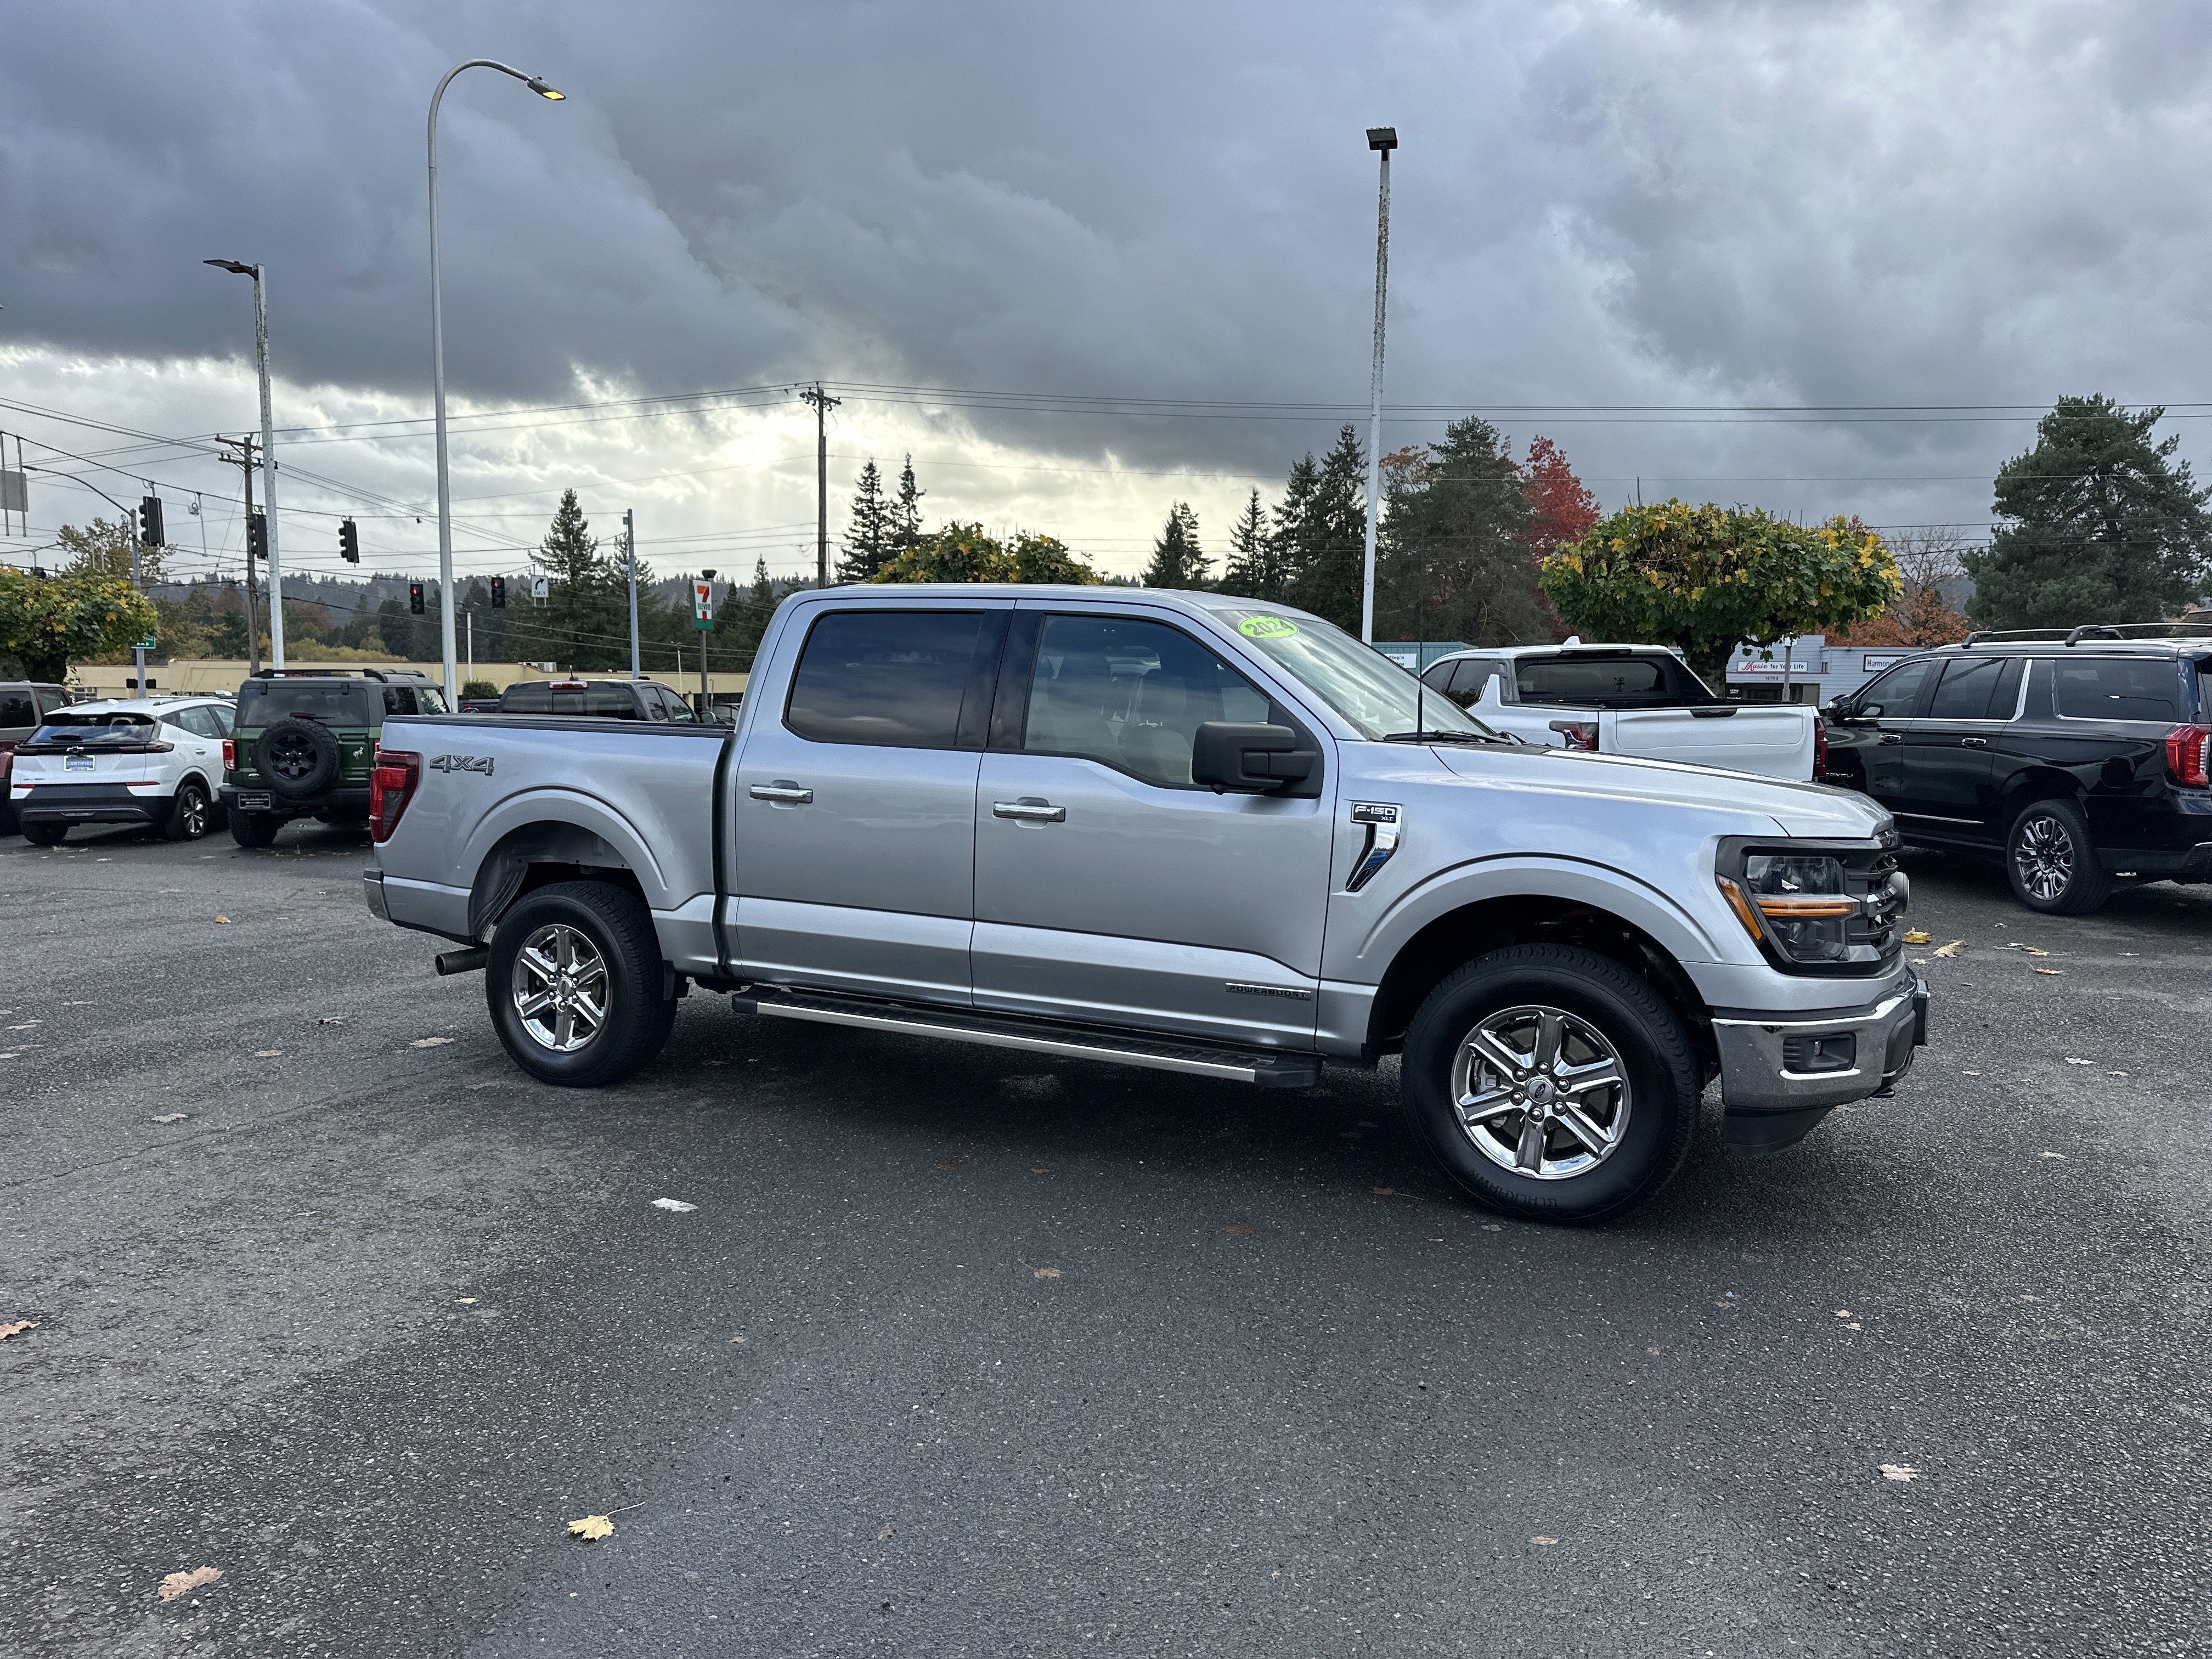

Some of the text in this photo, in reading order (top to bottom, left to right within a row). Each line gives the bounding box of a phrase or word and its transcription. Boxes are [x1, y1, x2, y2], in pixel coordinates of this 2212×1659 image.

[1245, 620, 1294, 636] 2024
[1741, 661, 1768, 671] Music
[1355, 805, 1396, 815] F-150
[1229, 986, 1306, 998] POWERBOOST
[1466, 1169, 1558, 1207] BLACKHAWK
